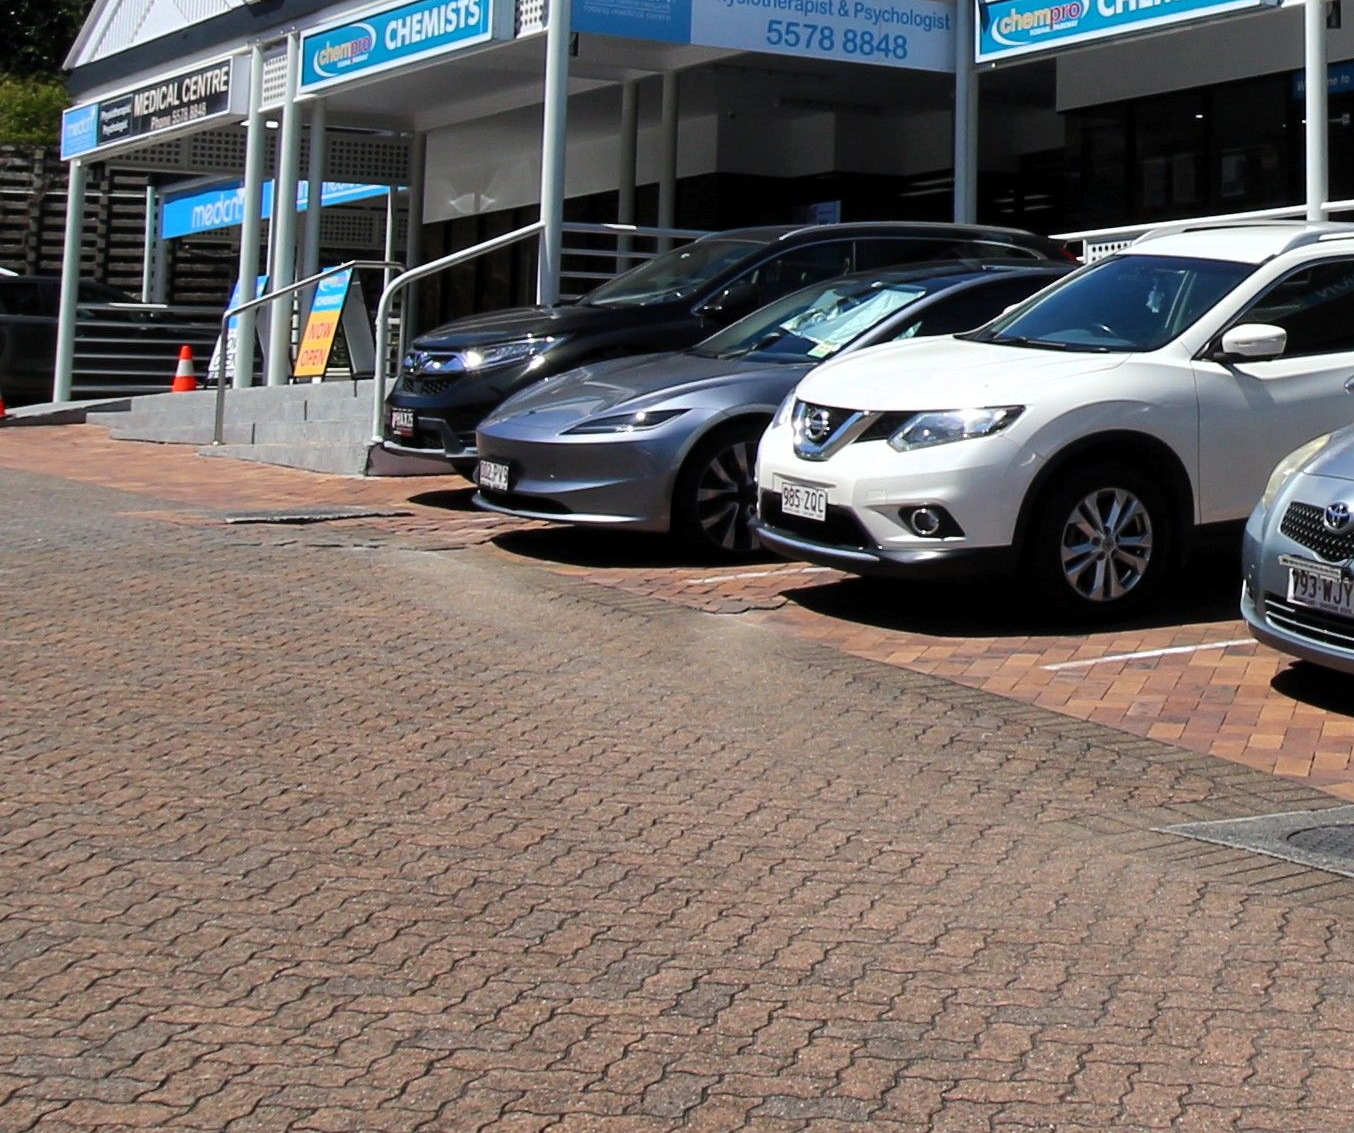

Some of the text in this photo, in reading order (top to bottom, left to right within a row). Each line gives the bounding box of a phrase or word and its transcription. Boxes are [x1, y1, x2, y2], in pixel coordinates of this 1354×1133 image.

[838, 0, 849, 17] &
[854, 1, 951, 32] Psychologist
[1000, 1, 1082, 35] chempro
[766, 19, 908, 59] 5578 8848
[133, 65, 229, 117] MEDICAL CENTRE
[307, 321, 334, 340] NOW
[300, 348, 328, 367] OPEN
